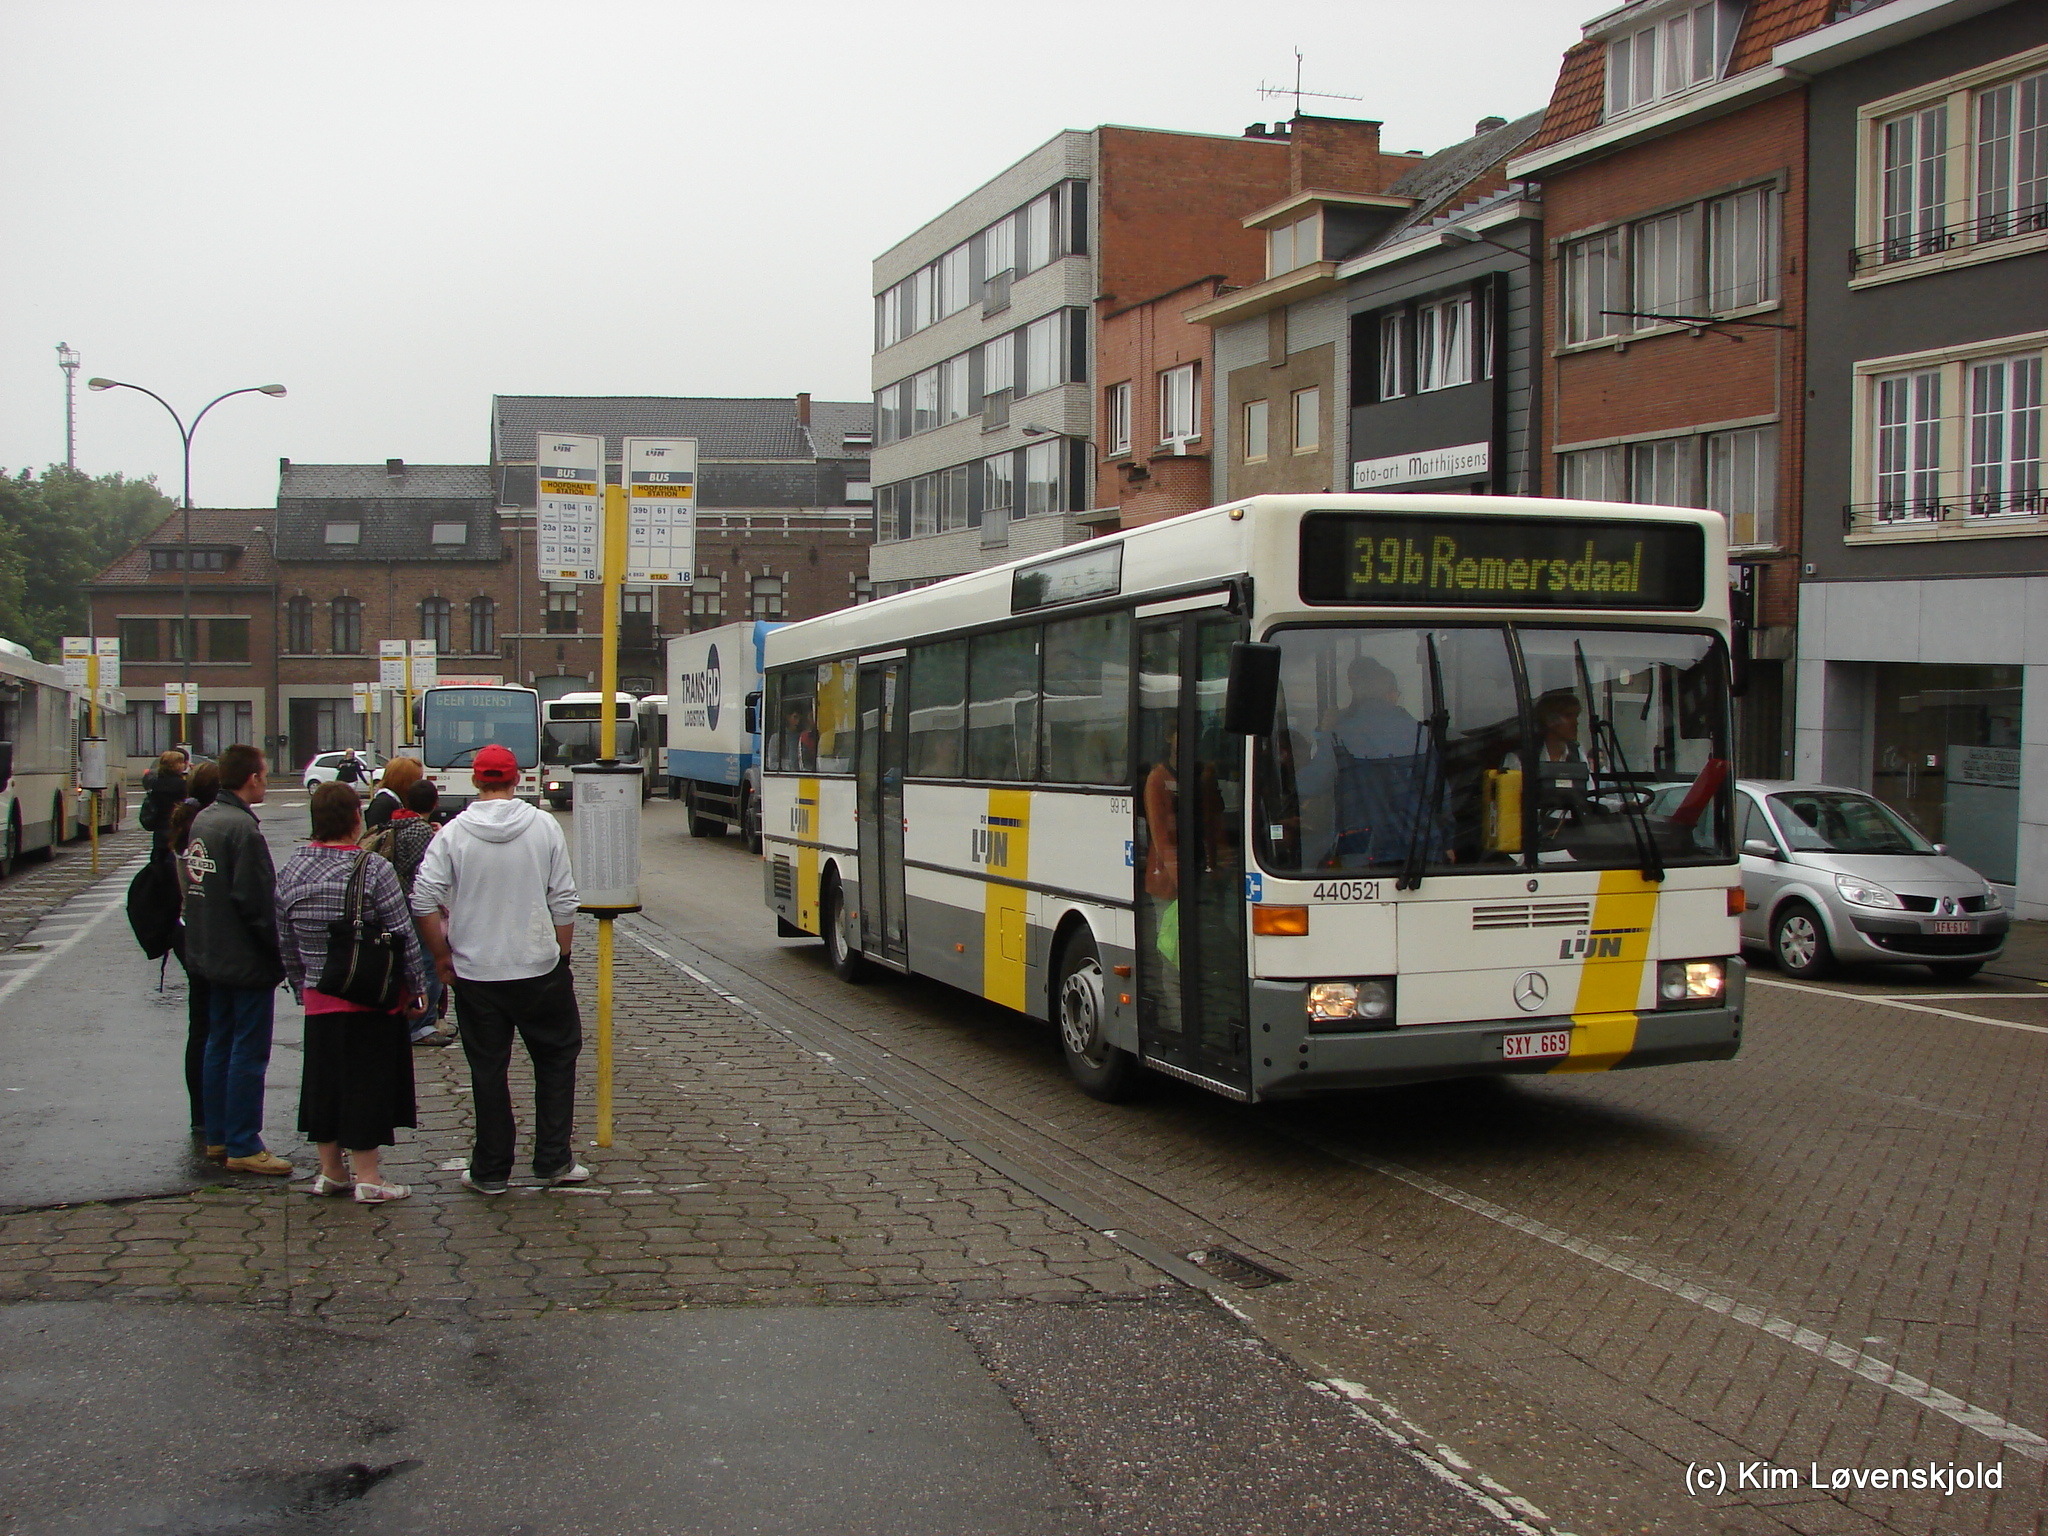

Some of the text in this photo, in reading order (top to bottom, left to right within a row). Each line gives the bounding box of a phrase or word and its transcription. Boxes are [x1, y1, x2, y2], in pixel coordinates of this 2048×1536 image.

[556, 468, 577, 479] BUS
[1355, 453, 1487, 483] foto-art Matthijssens
[649, 472, 670, 482] BUS
[547, 481, 592, 491] HOOFDHALTE
[563, 503, 576, 511] 104
[677, 507, 687, 515] 62
[1352, 535, 1643, 592] 39b Remersdaal
[584, 569, 595, 580] 18
[677, 571, 690, 581] 18
[681, 667, 720, 707] TRANS RD
[436, 694, 513, 707] GEEN DIENST
[684, 709, 705, 727] LOGISTICS
[1110, 797, 1131, 814] 99 PL
[790, 807, 809, 834] LIJN
[971, 828, 1008, 867] LIJN
[1312, 881, 1379, 901] 440521
[1558, 936, 1622, 960] LIJN
